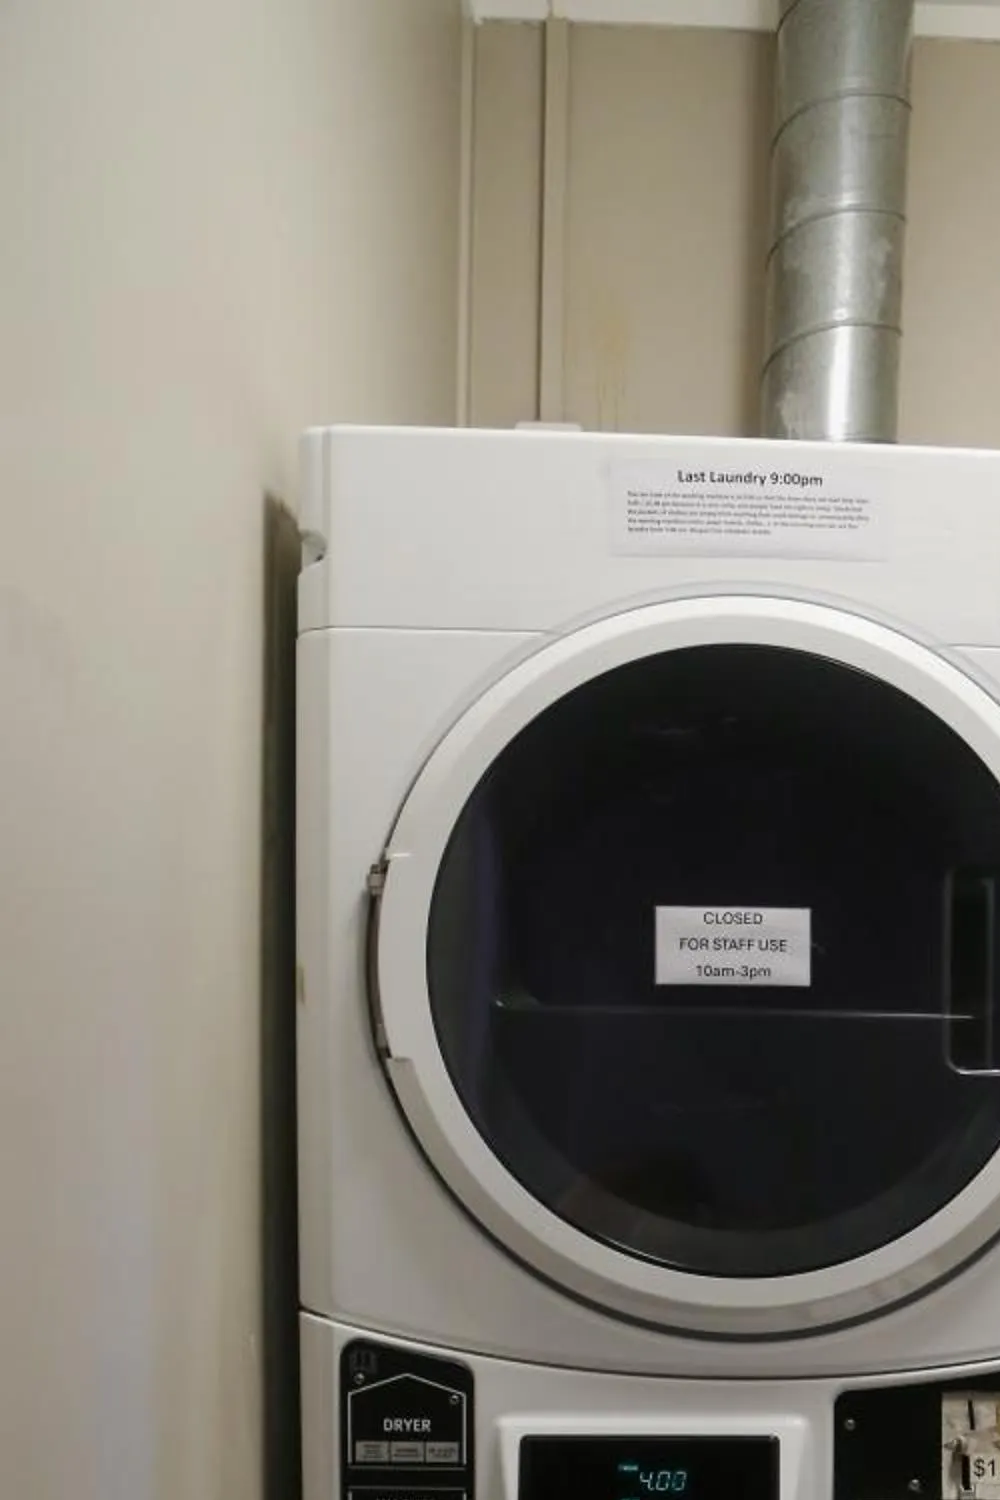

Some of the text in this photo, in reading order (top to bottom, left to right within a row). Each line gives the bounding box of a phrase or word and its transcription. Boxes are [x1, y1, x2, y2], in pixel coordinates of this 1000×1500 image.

[677, 470, 823, 488] Last Laundry 9:00pm
[703, 911, 763, 925] CLOSED
[679, 937, 788, 952] FOR STAFF USE
[696, 965, 771, 980] 10am-3pm
[383, 1418, 431, 1432] DRYER
[973, 1458, 996, 1478] $1
[639, 1470, 687, 1491] 4.00
